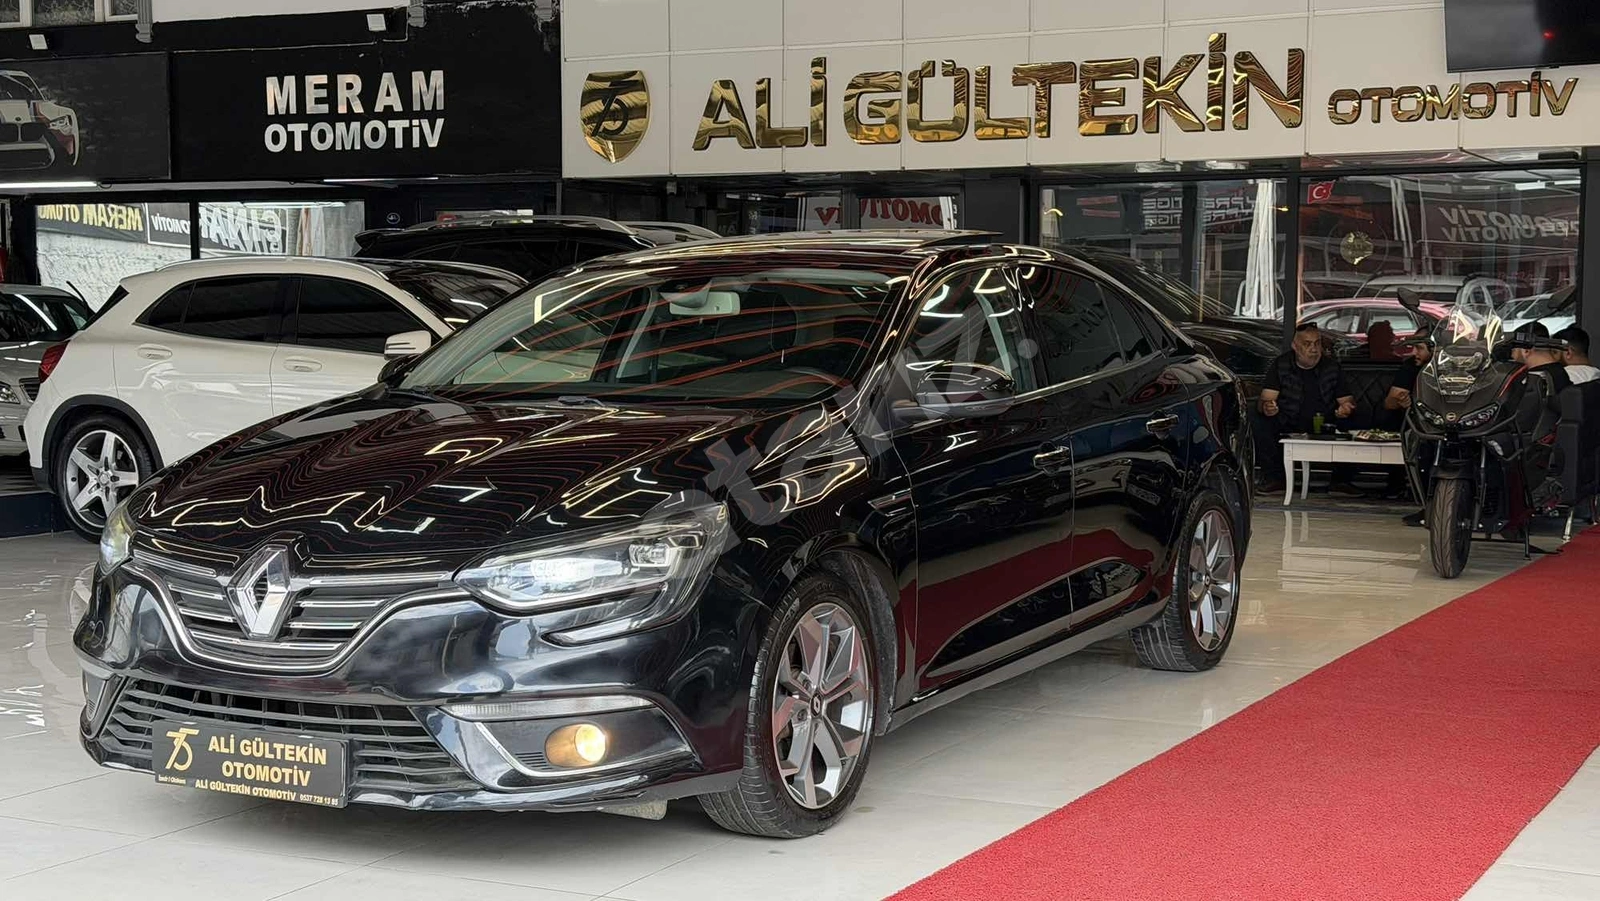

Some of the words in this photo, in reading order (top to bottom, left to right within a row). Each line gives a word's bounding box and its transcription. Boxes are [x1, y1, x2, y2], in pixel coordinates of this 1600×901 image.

[266, 69, 446, 116] MERAM
[692, 56, 828, 151] ALİ
[843, 31, 1305, 145] GÜLTEKİN
[1327, 71, 1579, 126] OTOMOTİV
[208, 734, 236, 753] ALİ
[240, 736, 327, 766] GÜLTEKİN
[195, 779, 208, 789] ALİ
[210, 780, 251, 795] GÜLTEKİN
[252, 787, 297, 801] OTOMOTİV
[222, 761, 311, 788] OTOMOTİV
